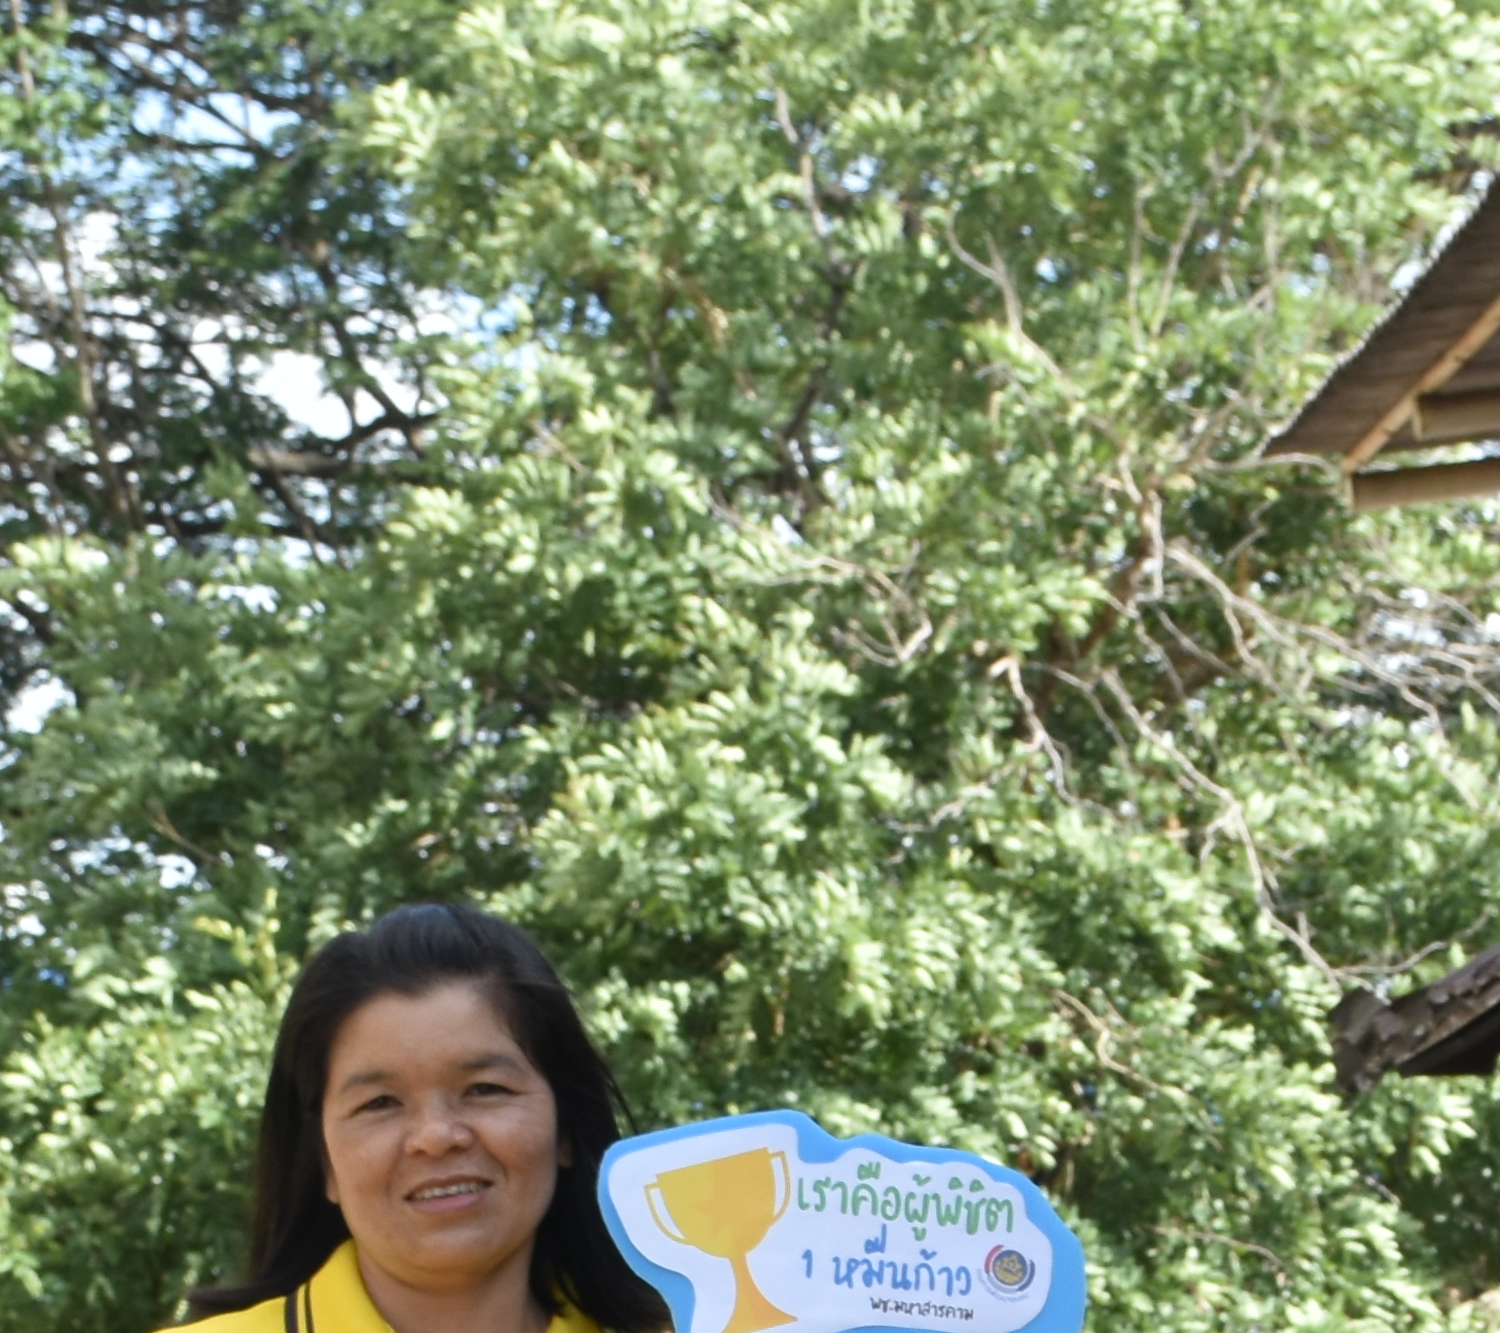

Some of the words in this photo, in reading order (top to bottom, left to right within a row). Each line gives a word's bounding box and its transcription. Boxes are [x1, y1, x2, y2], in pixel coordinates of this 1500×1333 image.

[797, 1162, 1015, 1241] เราคือผู้พิชิต
[801, 1248, 813, 1279] 1
[832, 1224, 973, 1297] หมื่นก้าว
